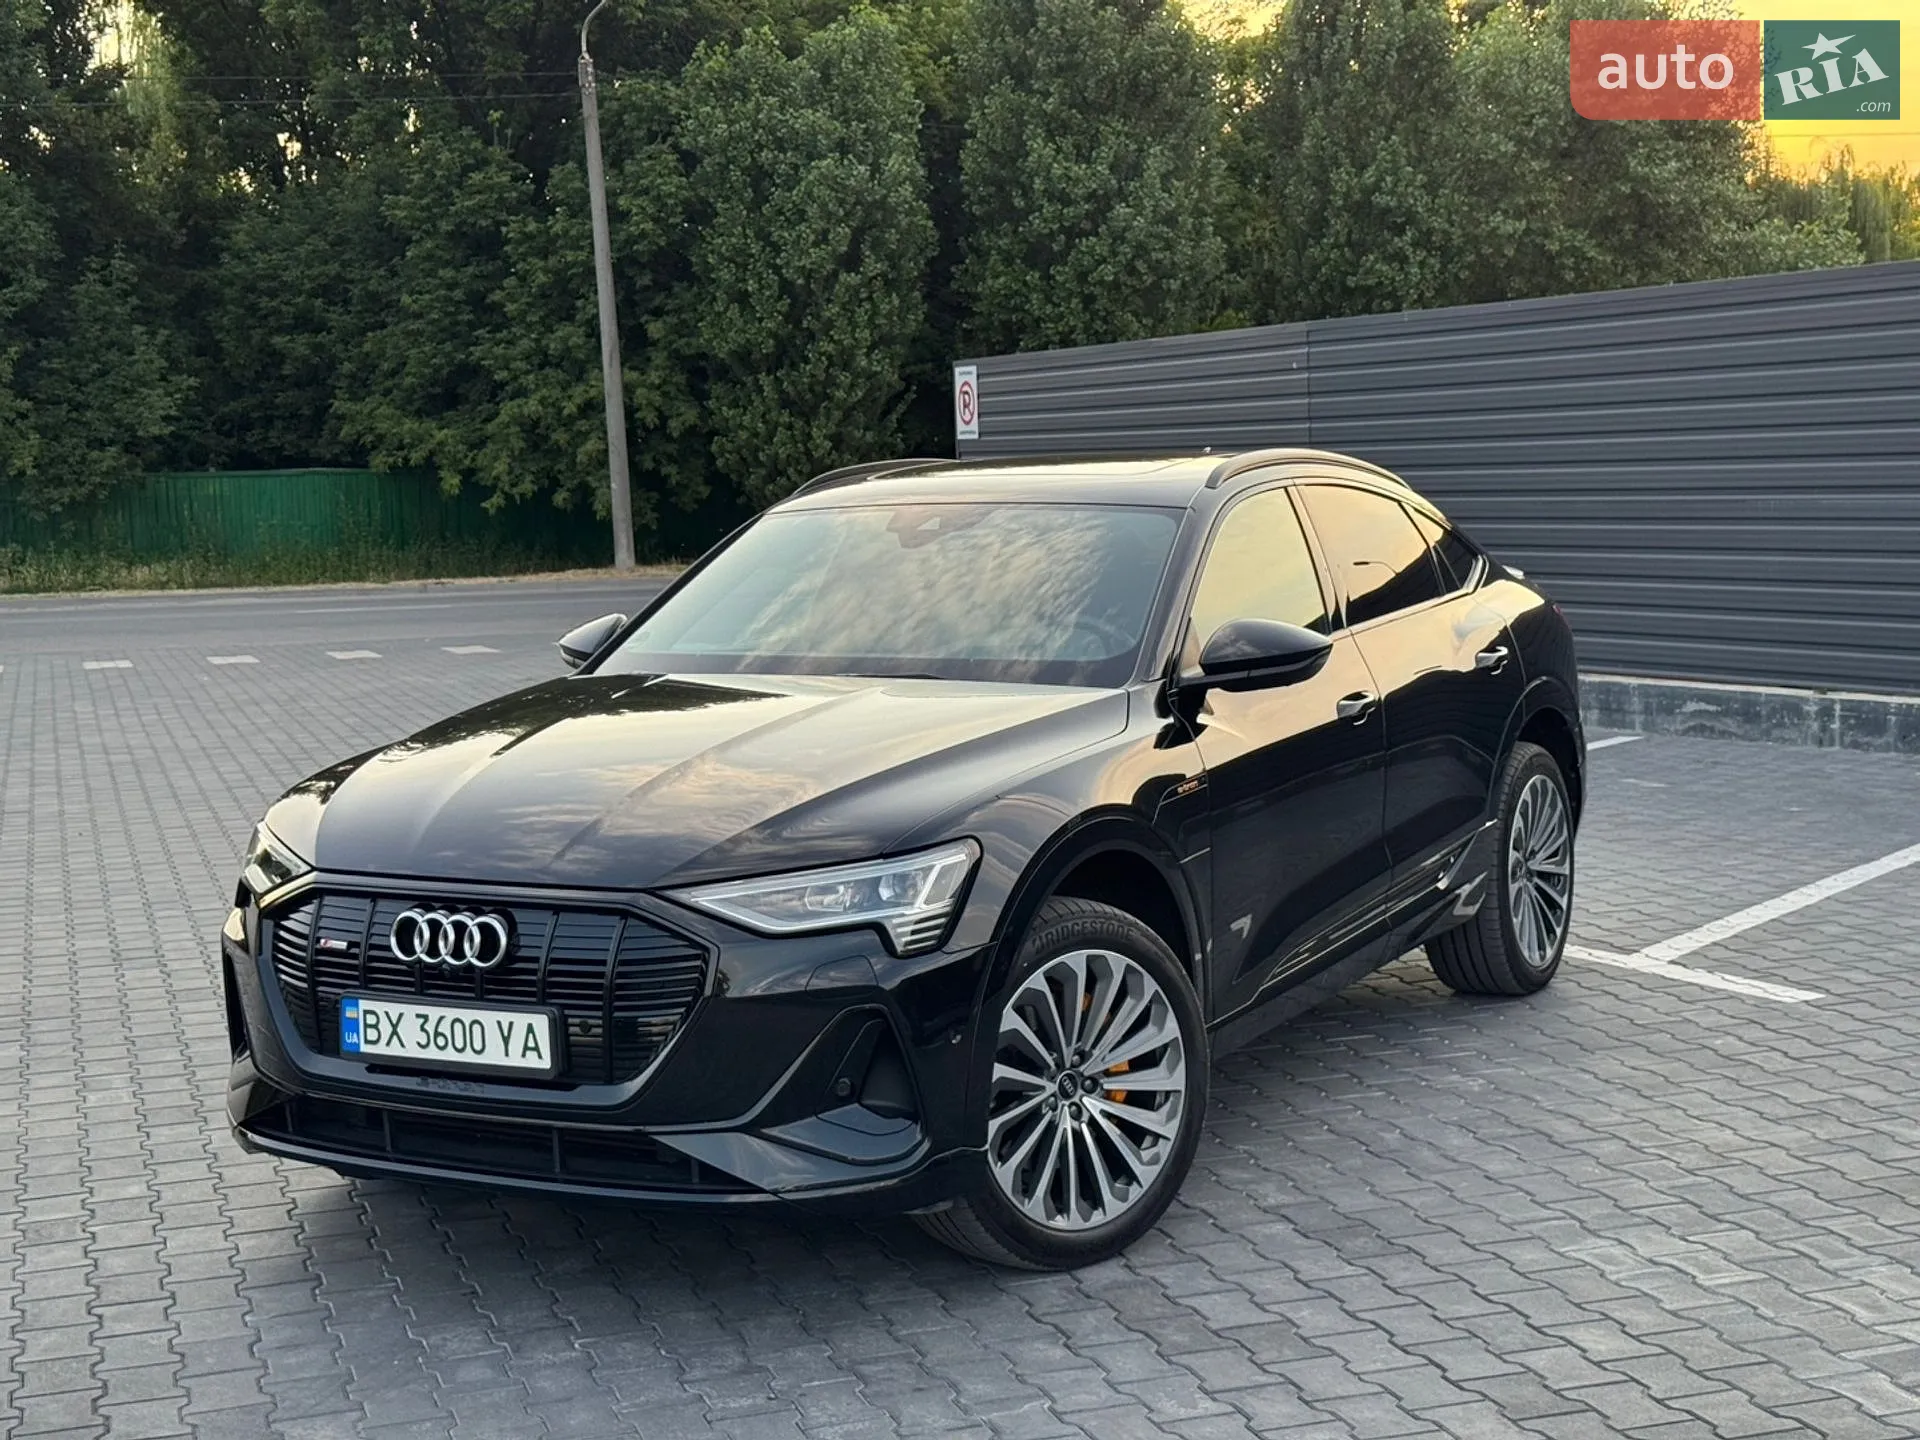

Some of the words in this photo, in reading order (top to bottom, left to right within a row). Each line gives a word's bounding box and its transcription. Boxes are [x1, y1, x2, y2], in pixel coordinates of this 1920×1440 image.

[1031, 919, 1134, 955] BRIDGESTONE
[345, 1031, 359, 1043] UA
[362, 1009, 406, 1049] BX
[414, 1013, 487, 1056] 3600
[496, 1019, 543, 1060] YA
